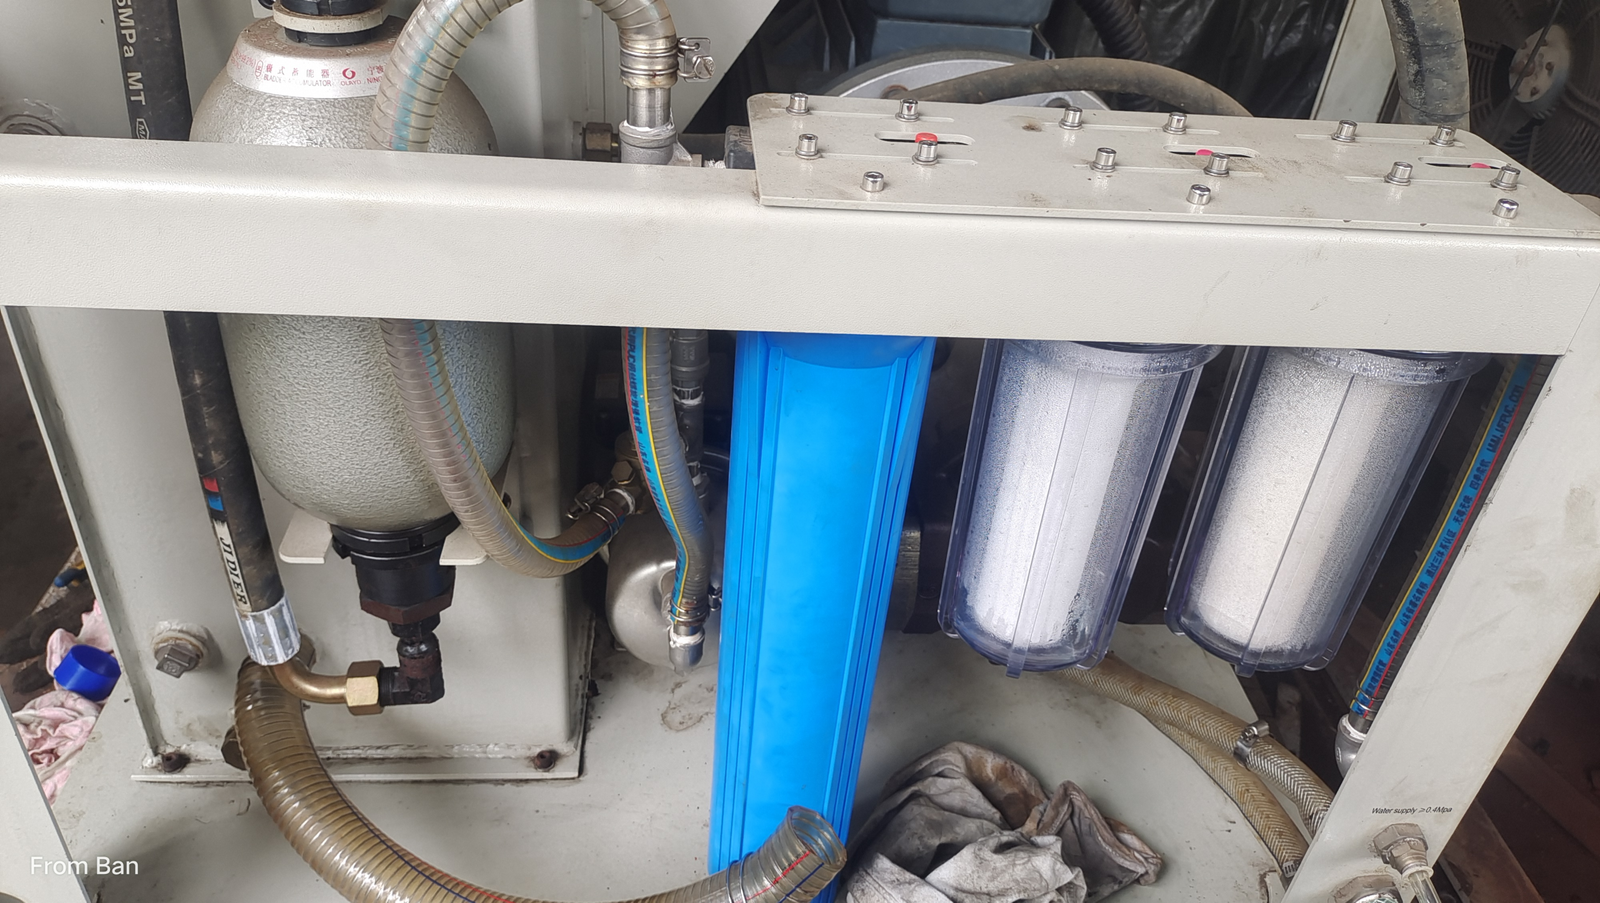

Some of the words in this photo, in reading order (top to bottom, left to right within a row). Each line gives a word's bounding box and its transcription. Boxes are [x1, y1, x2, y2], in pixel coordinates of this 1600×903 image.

[127, 71, 146, 105] MT
[1453, 494, 1474, 525] 无毒无味
[220, 537, 247, 606] JIDIER
[1393, 807, 1417, 815] supply
